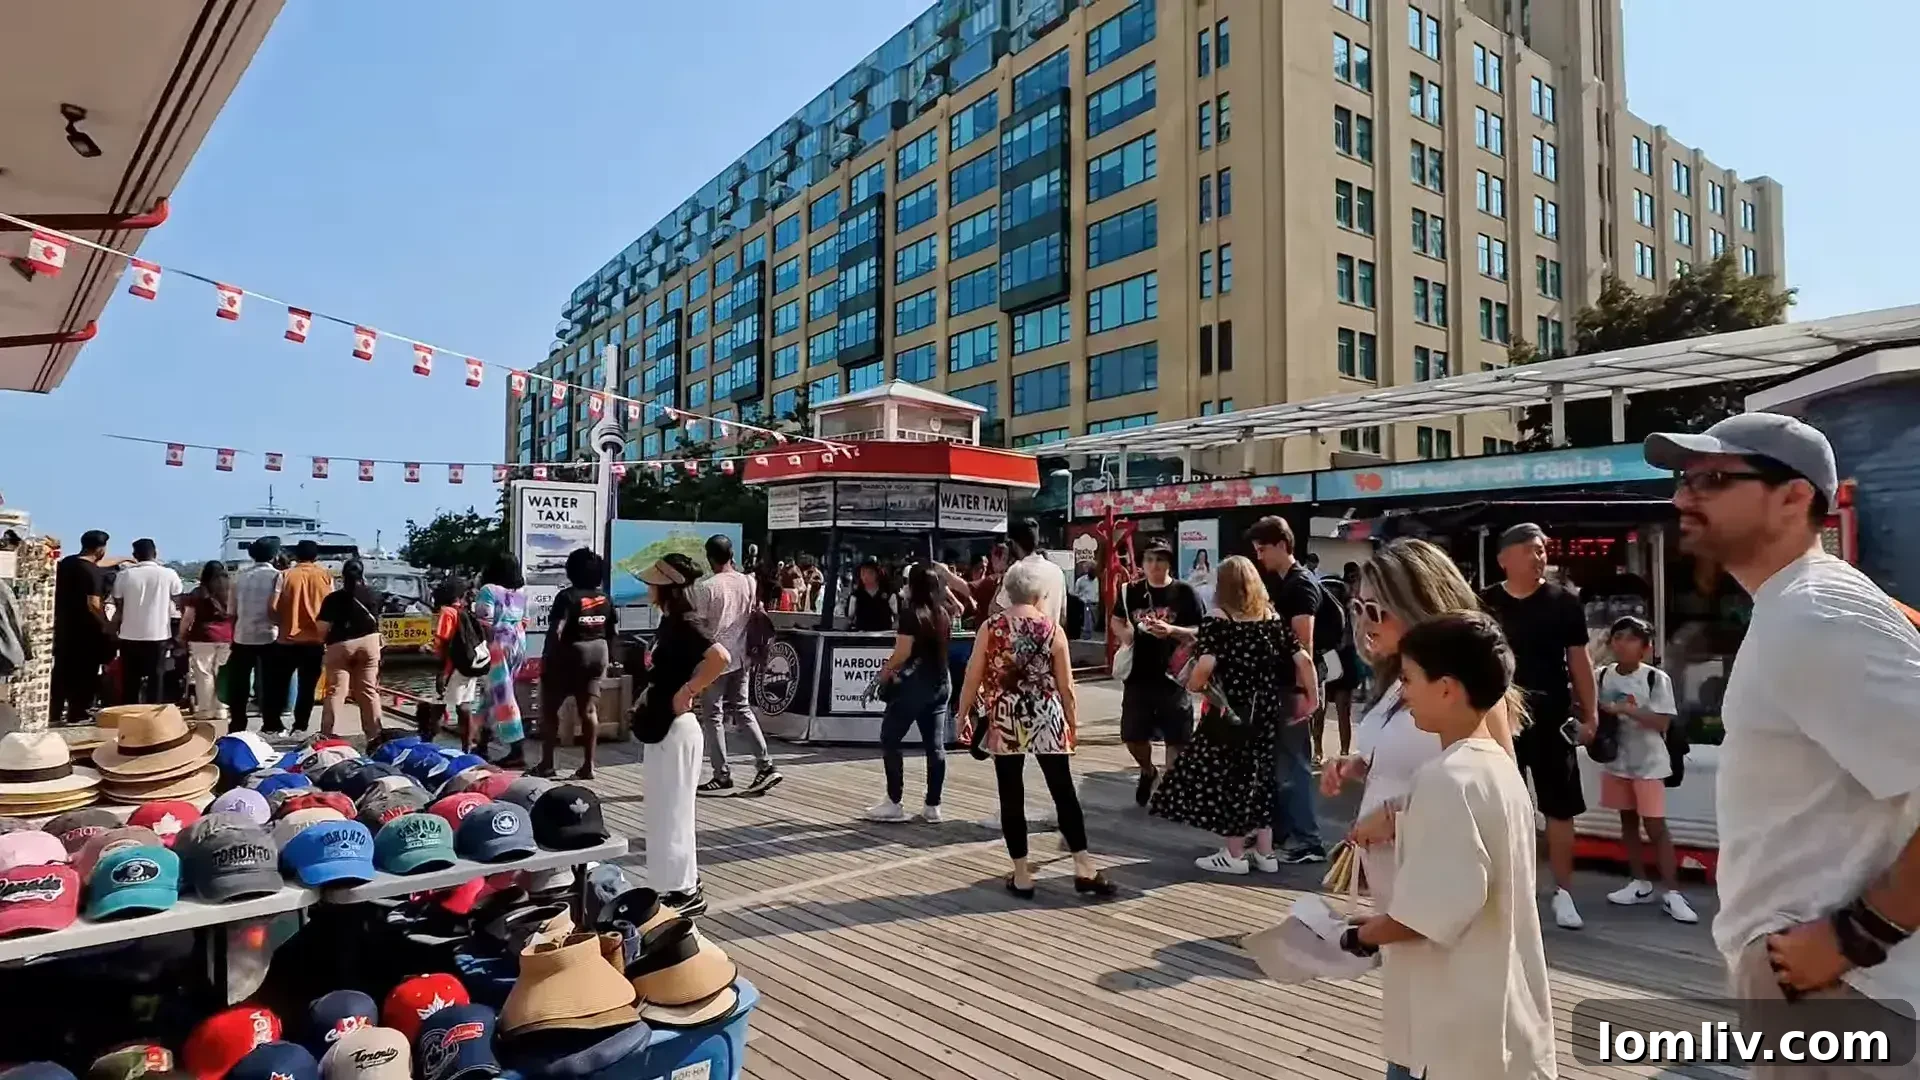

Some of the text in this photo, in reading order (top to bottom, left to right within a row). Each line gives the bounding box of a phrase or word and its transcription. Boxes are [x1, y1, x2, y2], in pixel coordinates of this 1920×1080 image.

[528, 495, 578, 508] WATER
[940, 492, 1007, 512] WATER TAXI
[537, 510, 570, 522] TAXI
[383, 621, 399, 629] 416
[844, 670, 880, 681] WATE
[836, 694, 865, 702] TOURIS
[397, 819, 442, 840] CANADA
[321, 829, 366, 847] TORONTO
[212, 843, 271, 867] TORONTO
